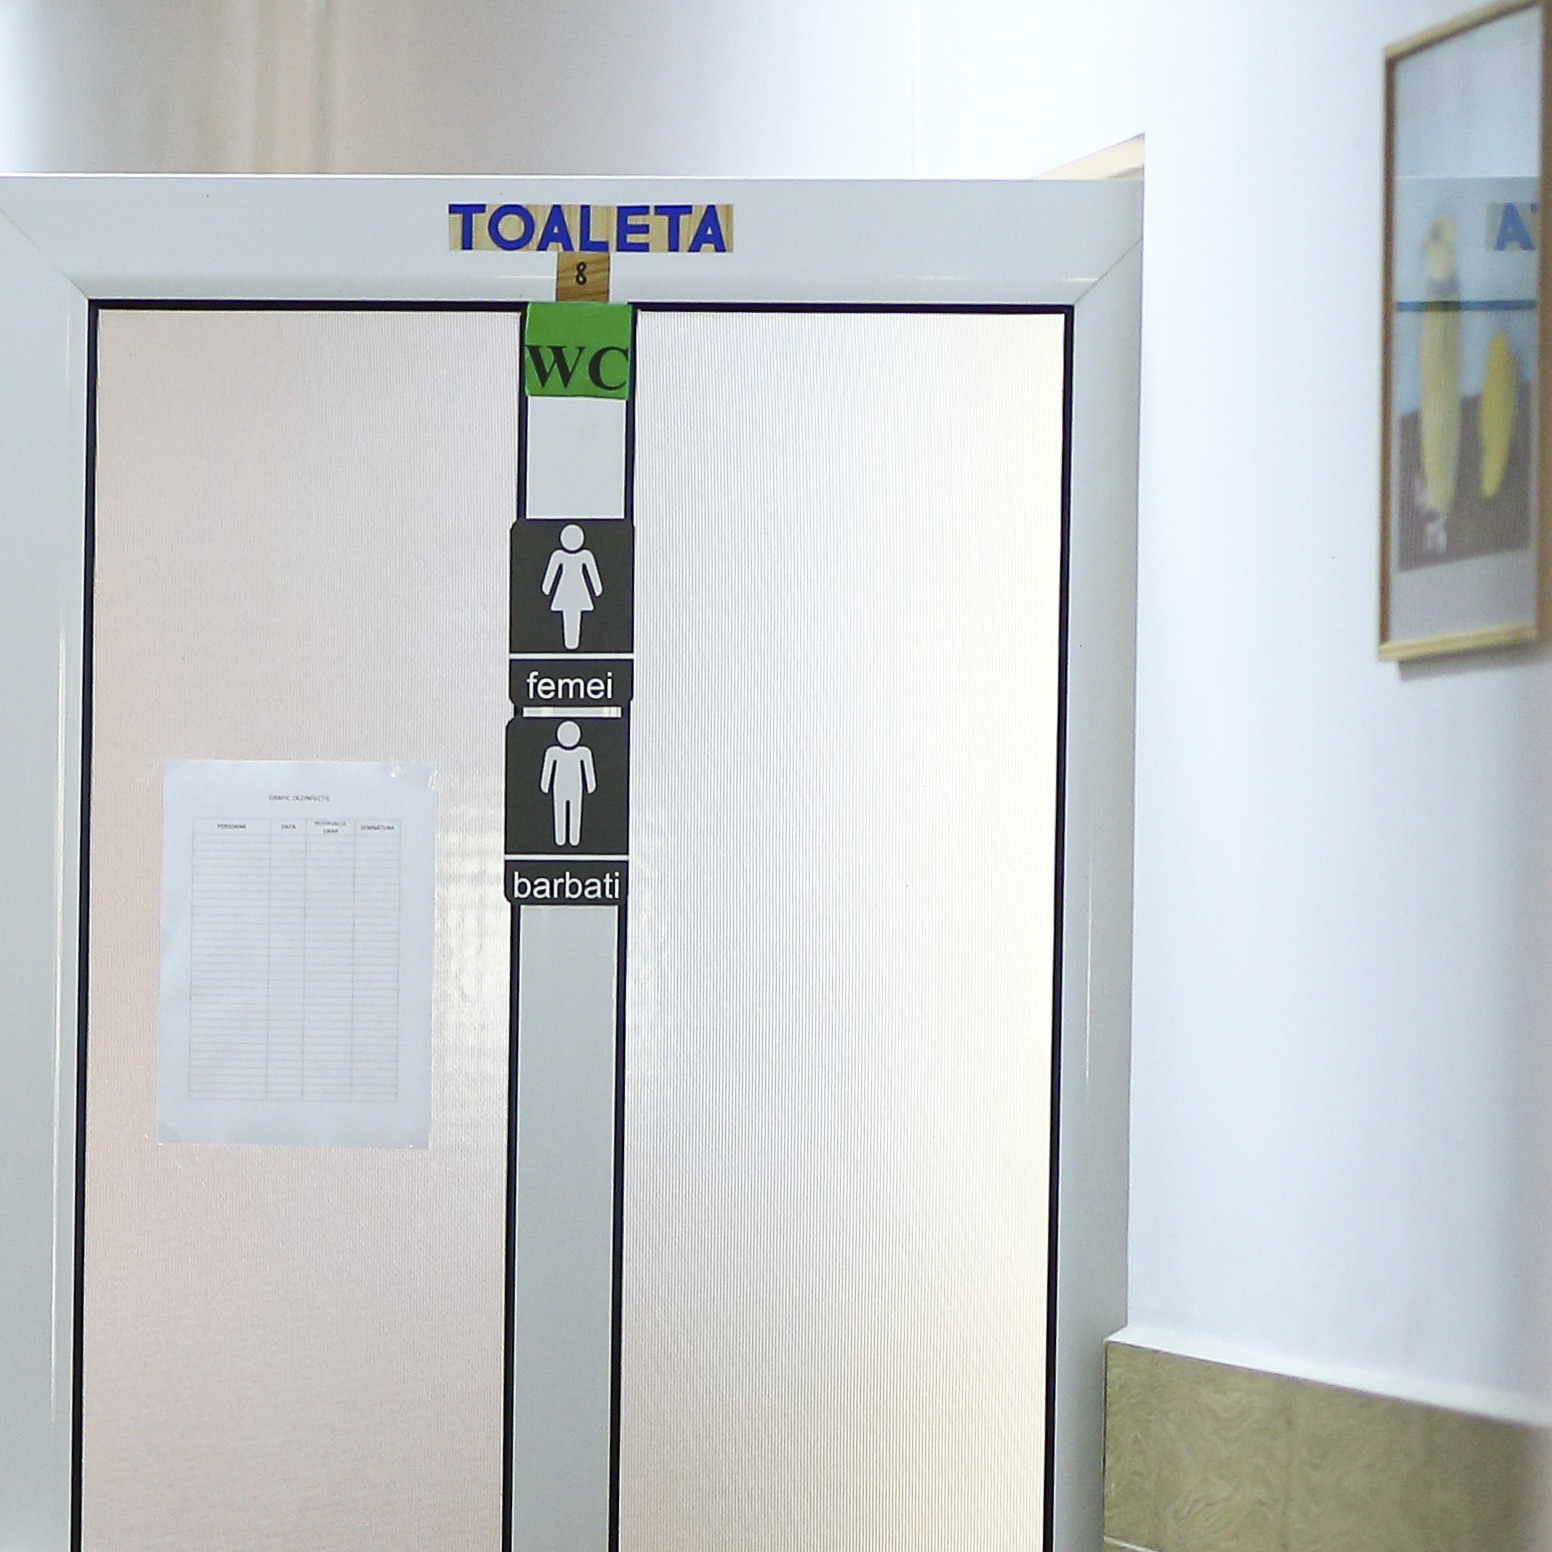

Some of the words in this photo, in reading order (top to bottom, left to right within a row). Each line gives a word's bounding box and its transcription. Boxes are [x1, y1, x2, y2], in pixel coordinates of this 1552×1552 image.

[448, 204, 727, 252] TOALETA
[575, 261, 587, 286] 8
[525, 344, 629, 391] WC
[526, 671, 614, 700] femei
[513, 871, 621, 899] barbati
